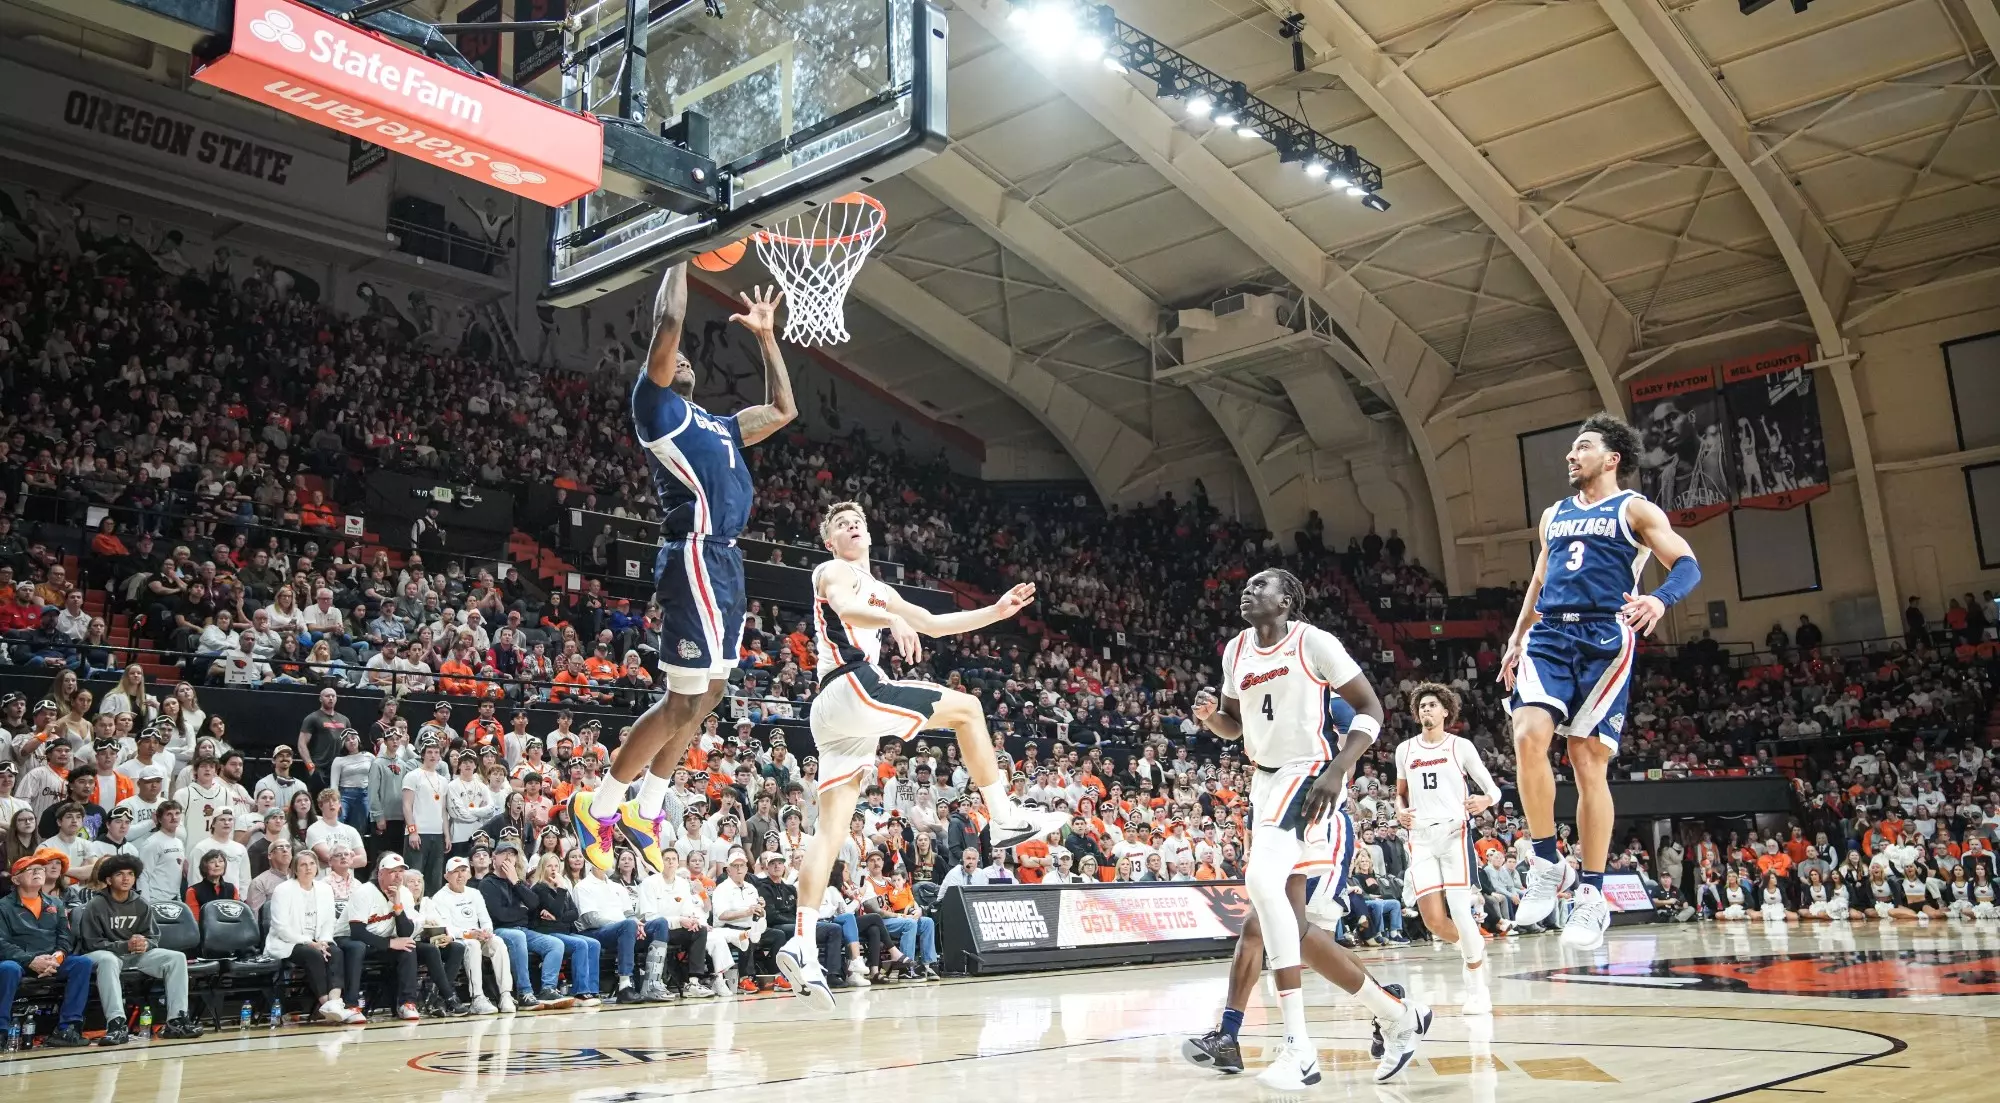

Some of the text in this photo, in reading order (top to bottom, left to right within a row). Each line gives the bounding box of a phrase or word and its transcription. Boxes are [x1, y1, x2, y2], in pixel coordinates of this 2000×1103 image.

[64, 89, 195, 157] OREGON
[197, 131, 294, 186] STATE
[1731, 354, 1802, 377] MEL COUNTS
[1636, 374, 1708, 397] GARY PAYTON
[720, 439, 736, 469] 7
[1777, 495, 1792, 505] 21
[1548, 518, 1617, 540] GONZAGA
[1680, 513, 1697, 523] 20
[1565, 541, 1586, 571] 3
[1562, 613, 1580, 622] ZAGS
[1240, 666, 1290, 691] Beavers
[1262, 693, 1274, 721] 4
[1410, 757, 1448, 769] Beavers
[1422, 772, 1438, 790] 13
[1120, 898, 1151, 910] CRAFT
[1154, 897, 1177, 909] BEER
[1179, 897, 1189, 908] OF
[110, 915, 138, 929] 1977
[1080, 910, 1198, 934] OSU ATHLETICS
